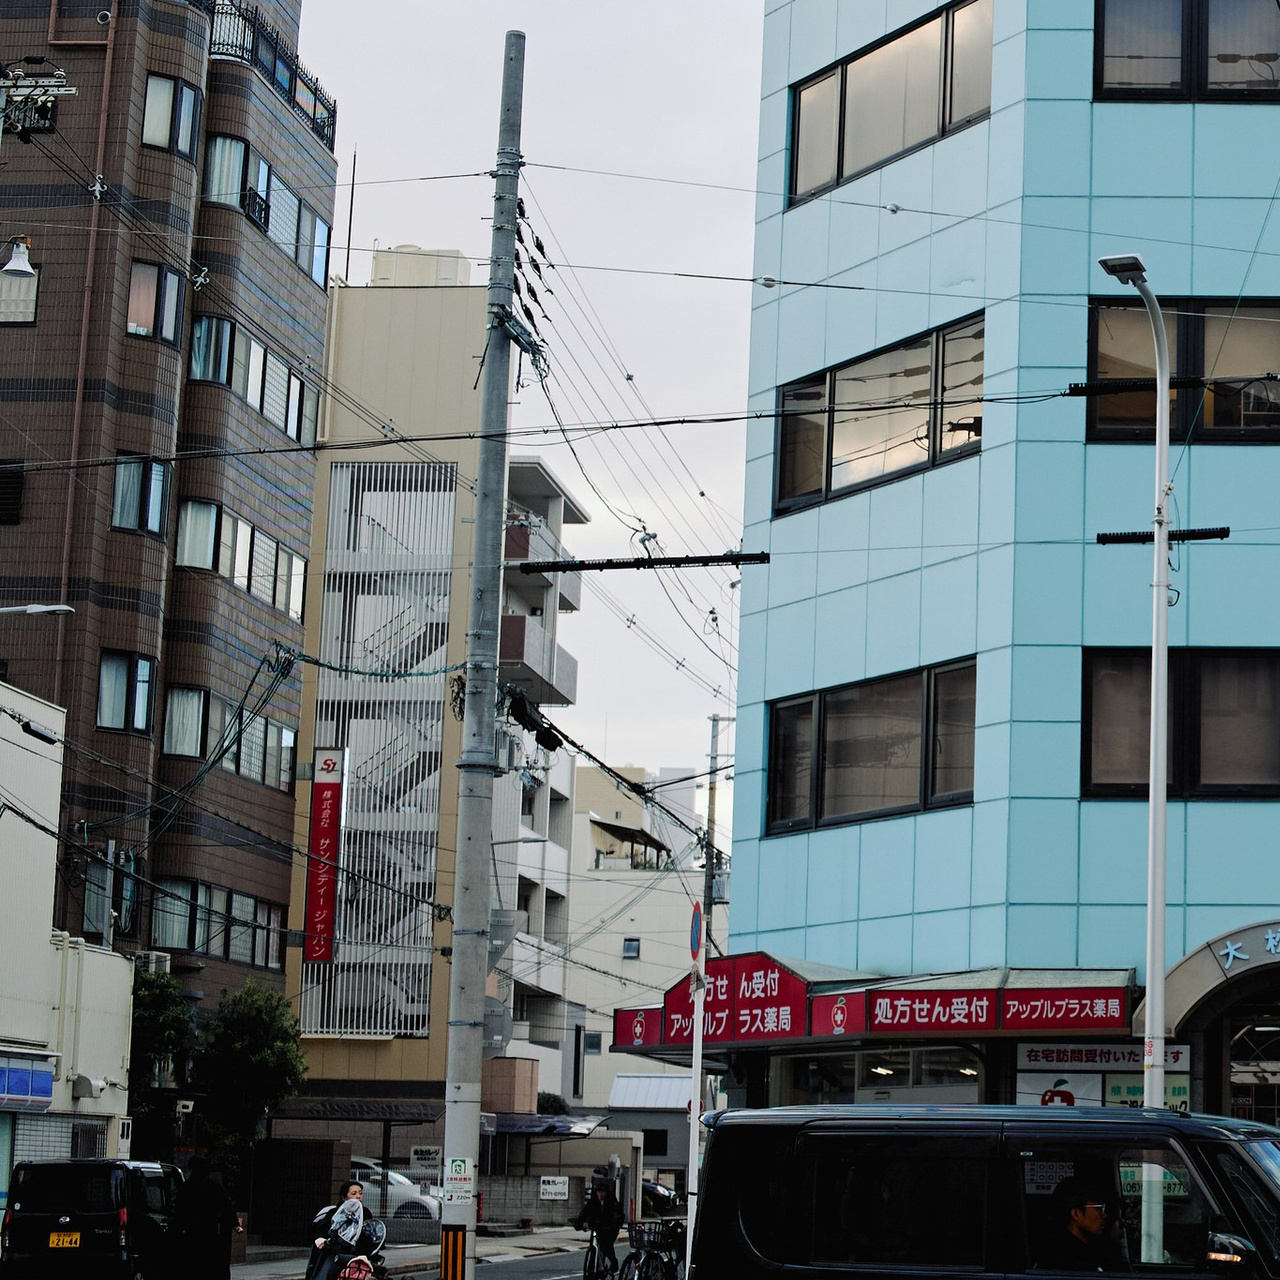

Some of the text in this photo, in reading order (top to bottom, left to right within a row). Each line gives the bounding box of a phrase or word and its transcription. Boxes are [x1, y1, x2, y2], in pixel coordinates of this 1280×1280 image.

[670, 1005, 792, 1037] アッルプラス薬局
[874, 996, 990, 1024] 処方せん受付
[1005, 998, 1121, 1020] アップルプラス薬局
[1026, 1048, 1183, 1063] 在宅訪問受付いたす
